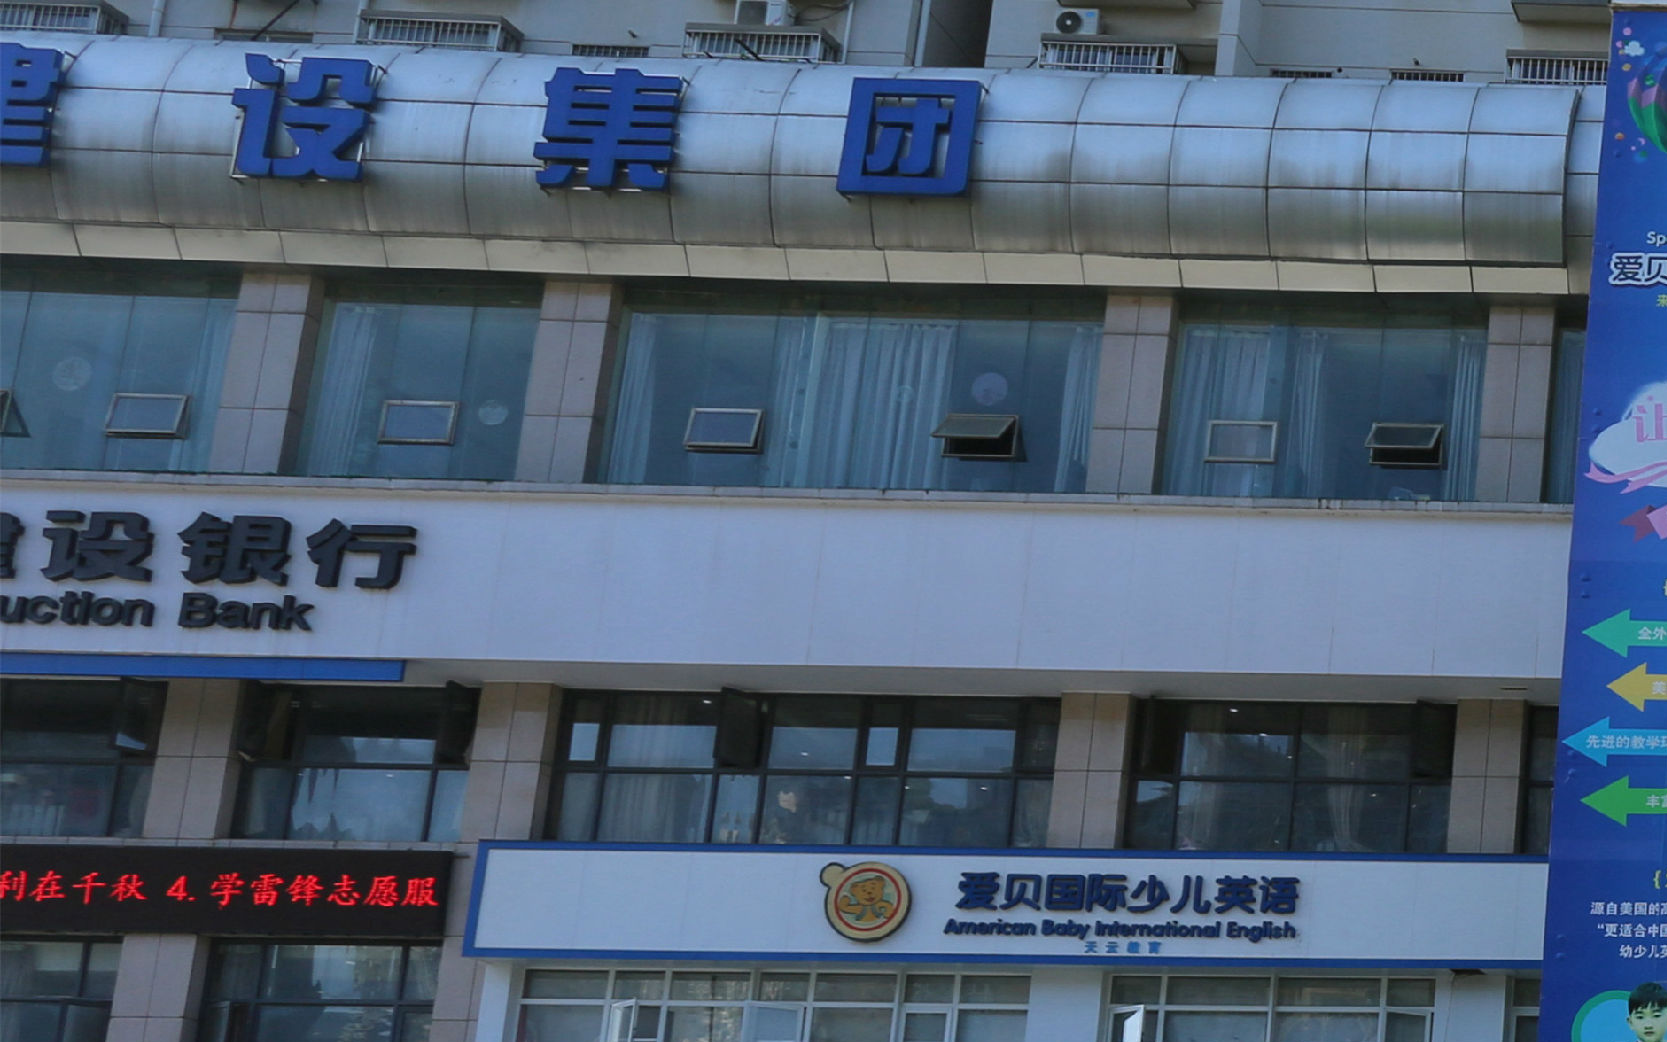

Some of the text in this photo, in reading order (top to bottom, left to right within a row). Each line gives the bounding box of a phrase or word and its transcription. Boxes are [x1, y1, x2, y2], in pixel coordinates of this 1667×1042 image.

[0, 510, 417, 589] 设银行
[178, 592, 316, 631] Bank
[0, 872, 146, 902] 利在千秋
[955, 871, 1300, 915] 爱贝国际少儿英语
[944, 918, 1296, 943] American Baby International English
